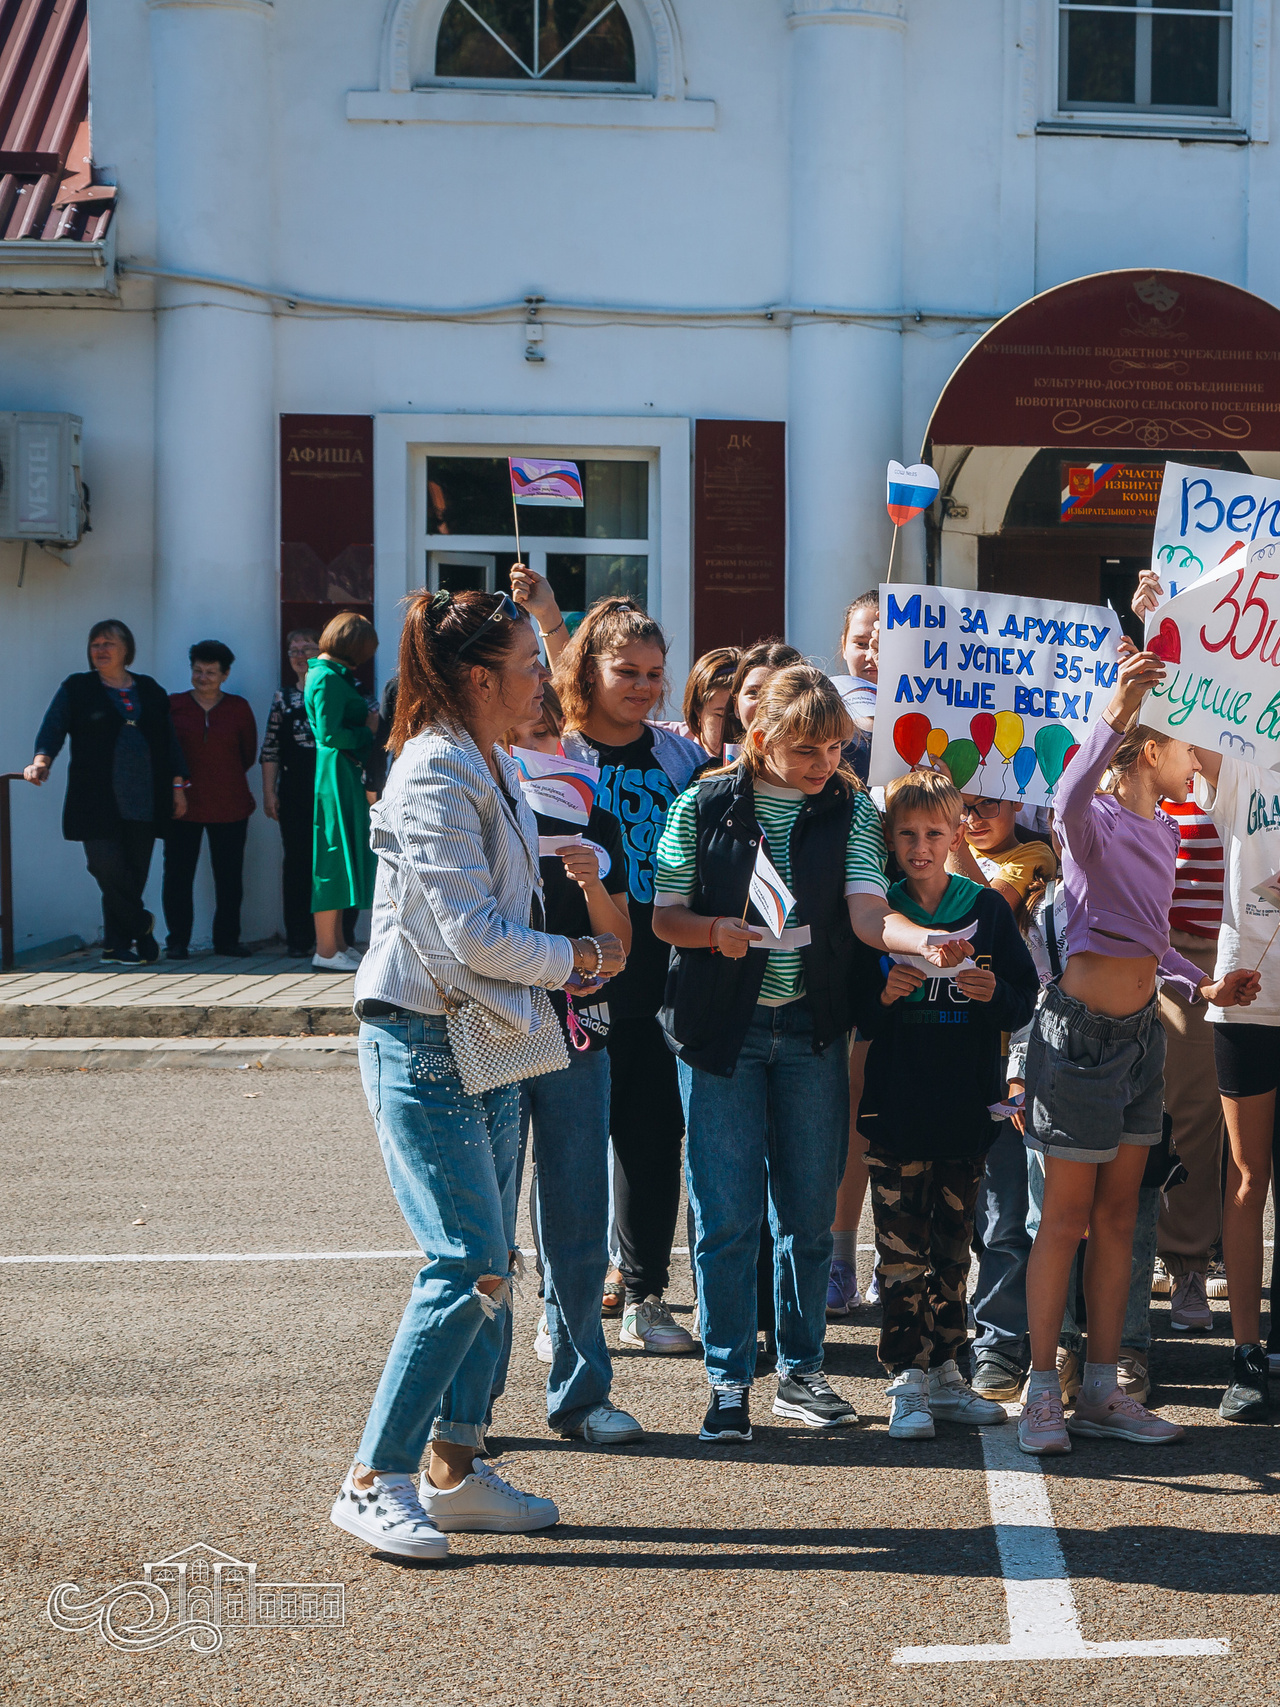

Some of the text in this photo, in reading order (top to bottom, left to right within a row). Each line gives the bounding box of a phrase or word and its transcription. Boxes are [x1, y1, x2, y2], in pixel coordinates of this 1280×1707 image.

[983, 343, 1093, 357] МУНИЦИПАЛЬНОЕ
[1094, 347, 1169, 359] БЮДЖЕТНОЕ
[1173, 348, 1251, 361] УЧРЕЖДЕНИЕ
[1034, 377, 1265, 394] КУЛЬТУРНО-ДОСУГОВОЕ ОБЪЕДИНЕНИЕ
[1015, 396, 1139, 409] НОВОТИТАРОВСКОГО
[1141, 399, 1209, 411] СЕЛЬСКОГО
[287, 446, 365, 464] АФИША
[29, 442, 48, 520] VESTEL
[1105, 480, 1162, 490] ИЗБИРАТ
[1122, 492, 1160, 502] КОМИ
[1067, 507, 1136, 516] ИЗБИРАТЕЛЬНОГО
[959, 607, 989, 635] ЗА
[998, 614, 1111, 652] ДРУЖБУ
[924, 640, 948, 670] И
[957, 643, 1036, 676] УСПЕХ
[894, 674, 1094, 723] ЛУЧШЕ ВСЕХ!
